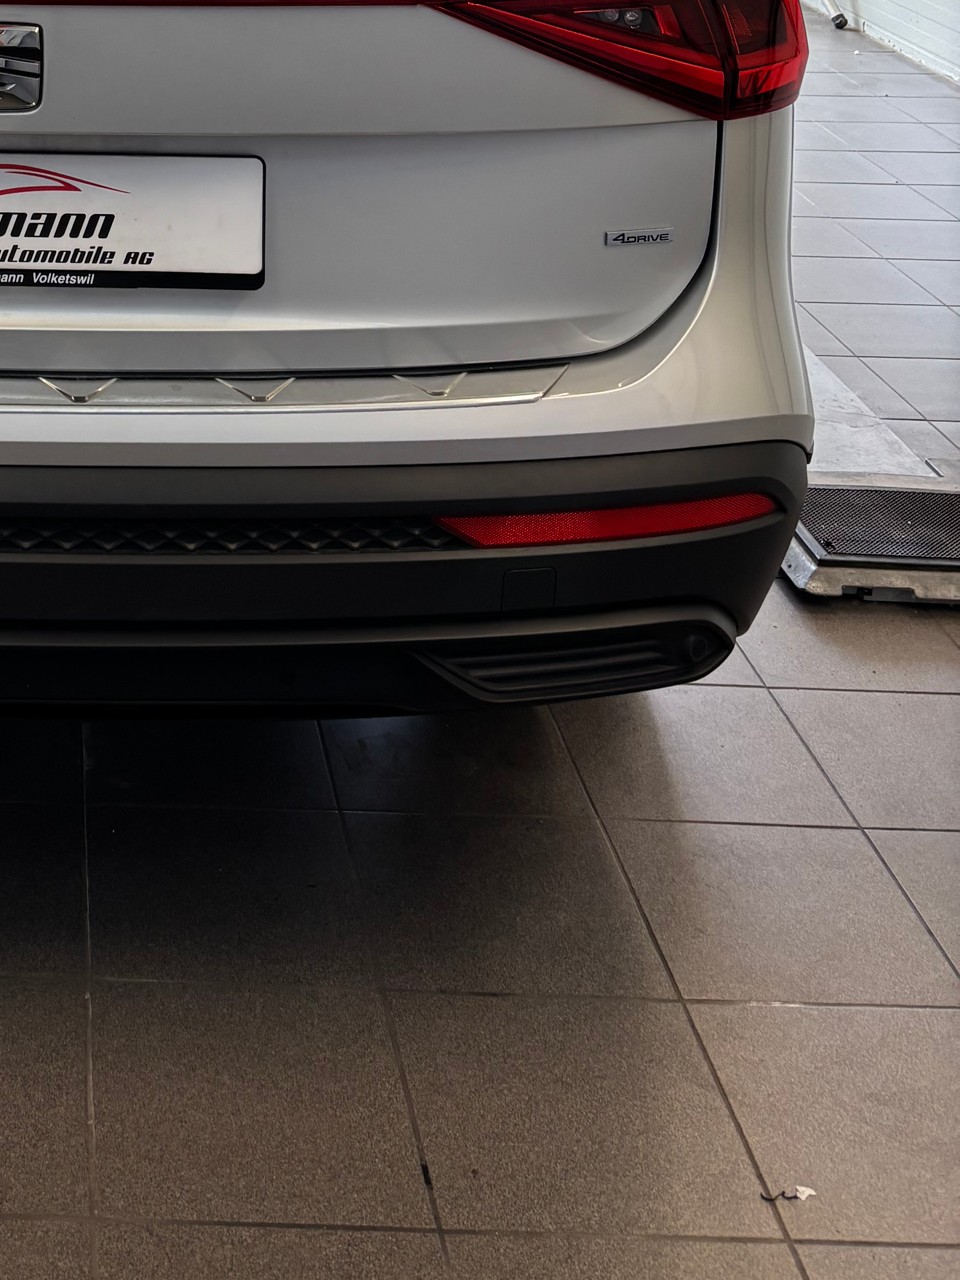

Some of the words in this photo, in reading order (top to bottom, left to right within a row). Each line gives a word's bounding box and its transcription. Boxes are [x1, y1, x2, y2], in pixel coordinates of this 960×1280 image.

[612, 232, 670, 244] 4DRIVE
[123, 251, 155, 266] AG
[32, 272, 95, 285] Volketswil
